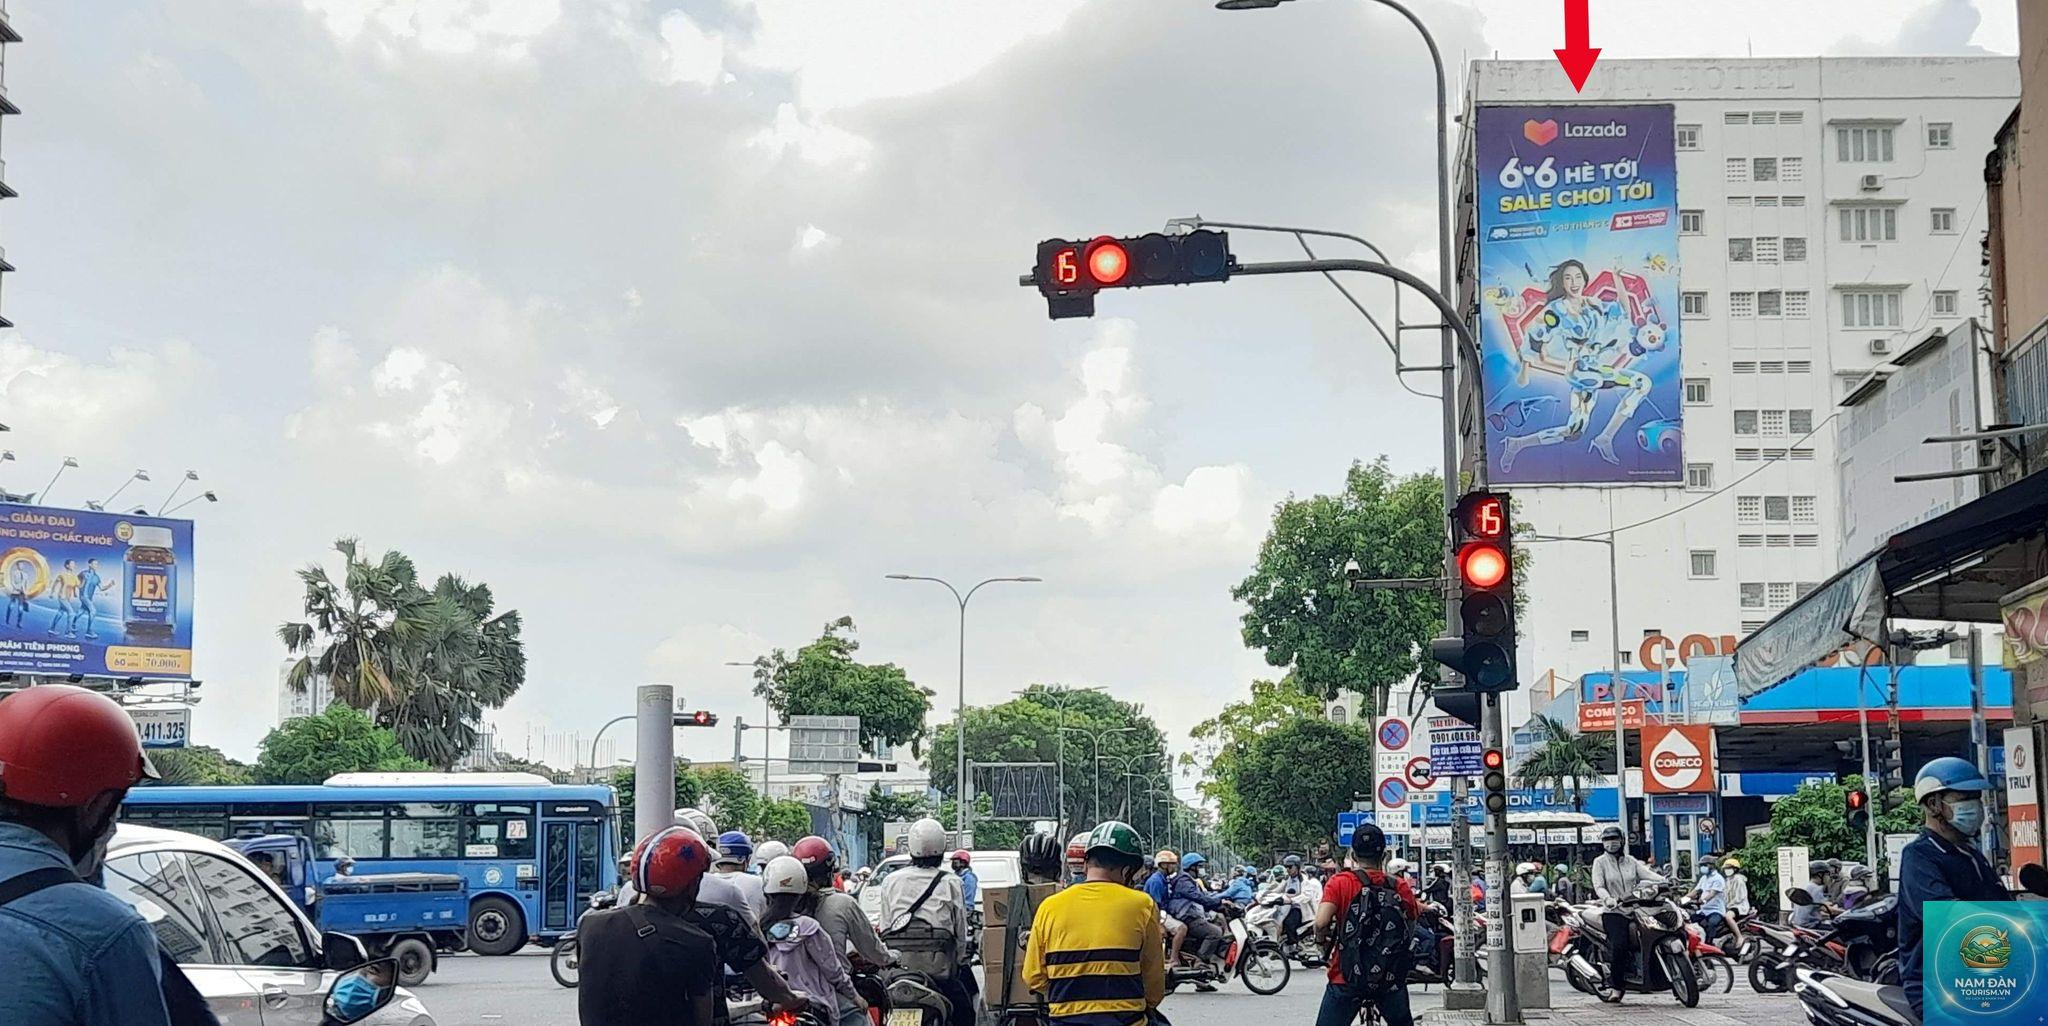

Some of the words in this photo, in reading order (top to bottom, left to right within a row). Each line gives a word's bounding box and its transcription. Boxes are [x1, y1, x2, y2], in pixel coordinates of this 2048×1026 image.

[1565, 121, 1627, 137] Lazada
[1565, 162, 1595, 184] HÈ
[1600, 157, 1639, 181] TỚI
[1500, 195, 1552, 213] SALE
[1557, 187, 1613, 207] CHƠI
[1617, 179, 1653, 202] TỚI
[1058, 252, 1077, 283] 15
[11, 511, 44, 524] GIẢM
[47, 516, 75, 527] ĐAU
[1481, 503, 1500, 535] 15
[0, 528, 16, 537] NG
[19, 529, 50, 540] KHỚP
[131, 574, 168, 599] JEX
[23, 641, 45, 651] TIÊN
[47, 643, 80, 652] PHONG
[1655, 757, 1703, 769] COMECO
[509, 821, 525, 837] 27
